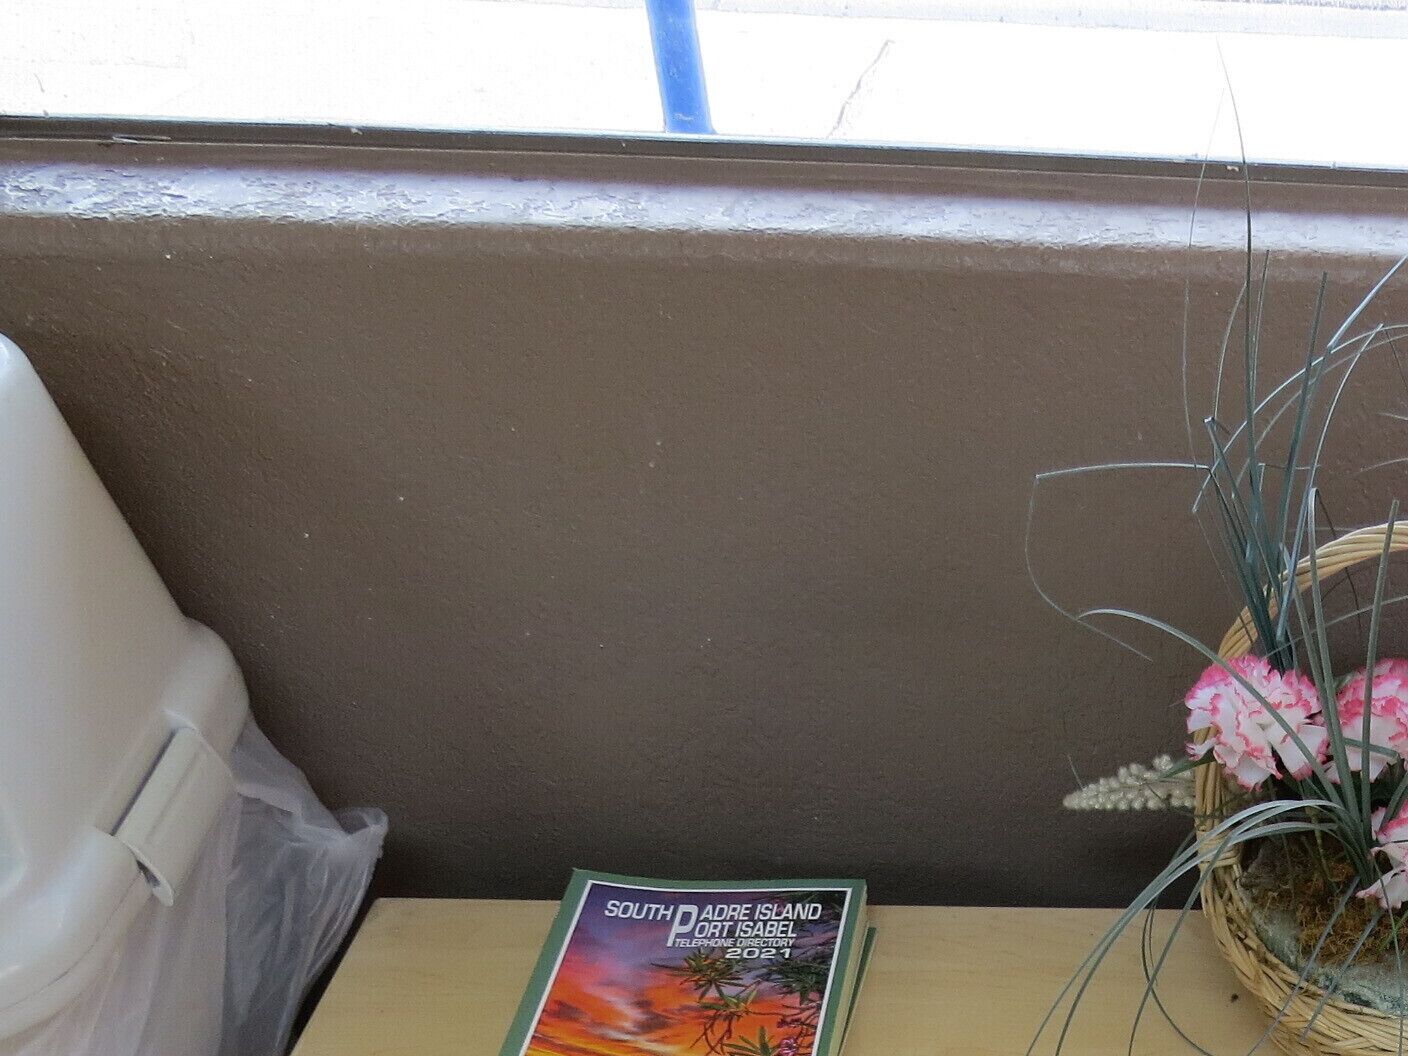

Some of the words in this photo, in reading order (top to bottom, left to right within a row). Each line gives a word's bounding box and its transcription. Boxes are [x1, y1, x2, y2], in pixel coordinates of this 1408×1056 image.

[604, 900, 674, 921] SOUTH
[754, 903, 822, 920] ISLAND
[735, 921, 797, 938] ISABEL
[674, 938, 735, 947] TELEPHONE
[736, 938, 795, 947] DIRECTORY
[725, 948, 791, 959] 2021
